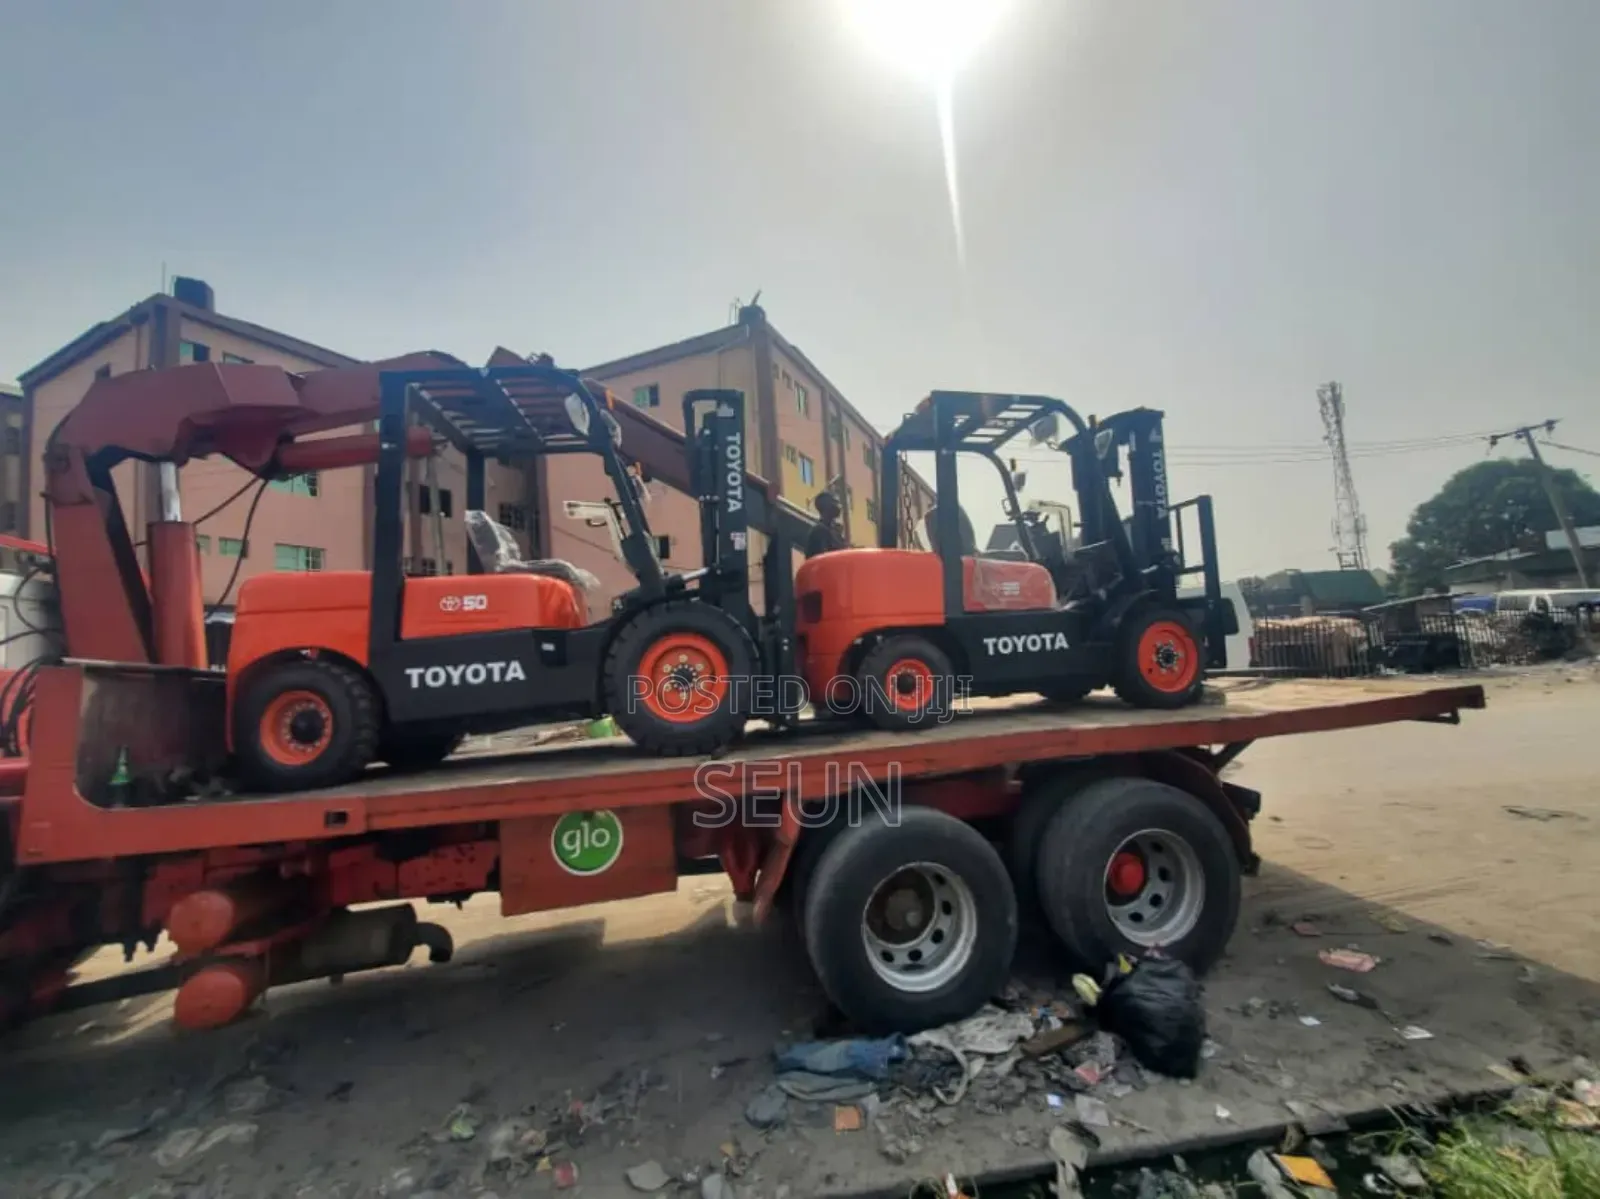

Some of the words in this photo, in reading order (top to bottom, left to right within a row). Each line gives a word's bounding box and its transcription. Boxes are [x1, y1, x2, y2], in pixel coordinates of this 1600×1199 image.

[726, 432, 742, 513] TOYOTA
[1152, 450, 1167, 519] TOYOTA
[463, 595, 487, 611] 50
[983, 632, 1069, 655] TOYOTA
[405, 660, 526, 689] TOYOTA
[561, 820, 610, 859] glo
